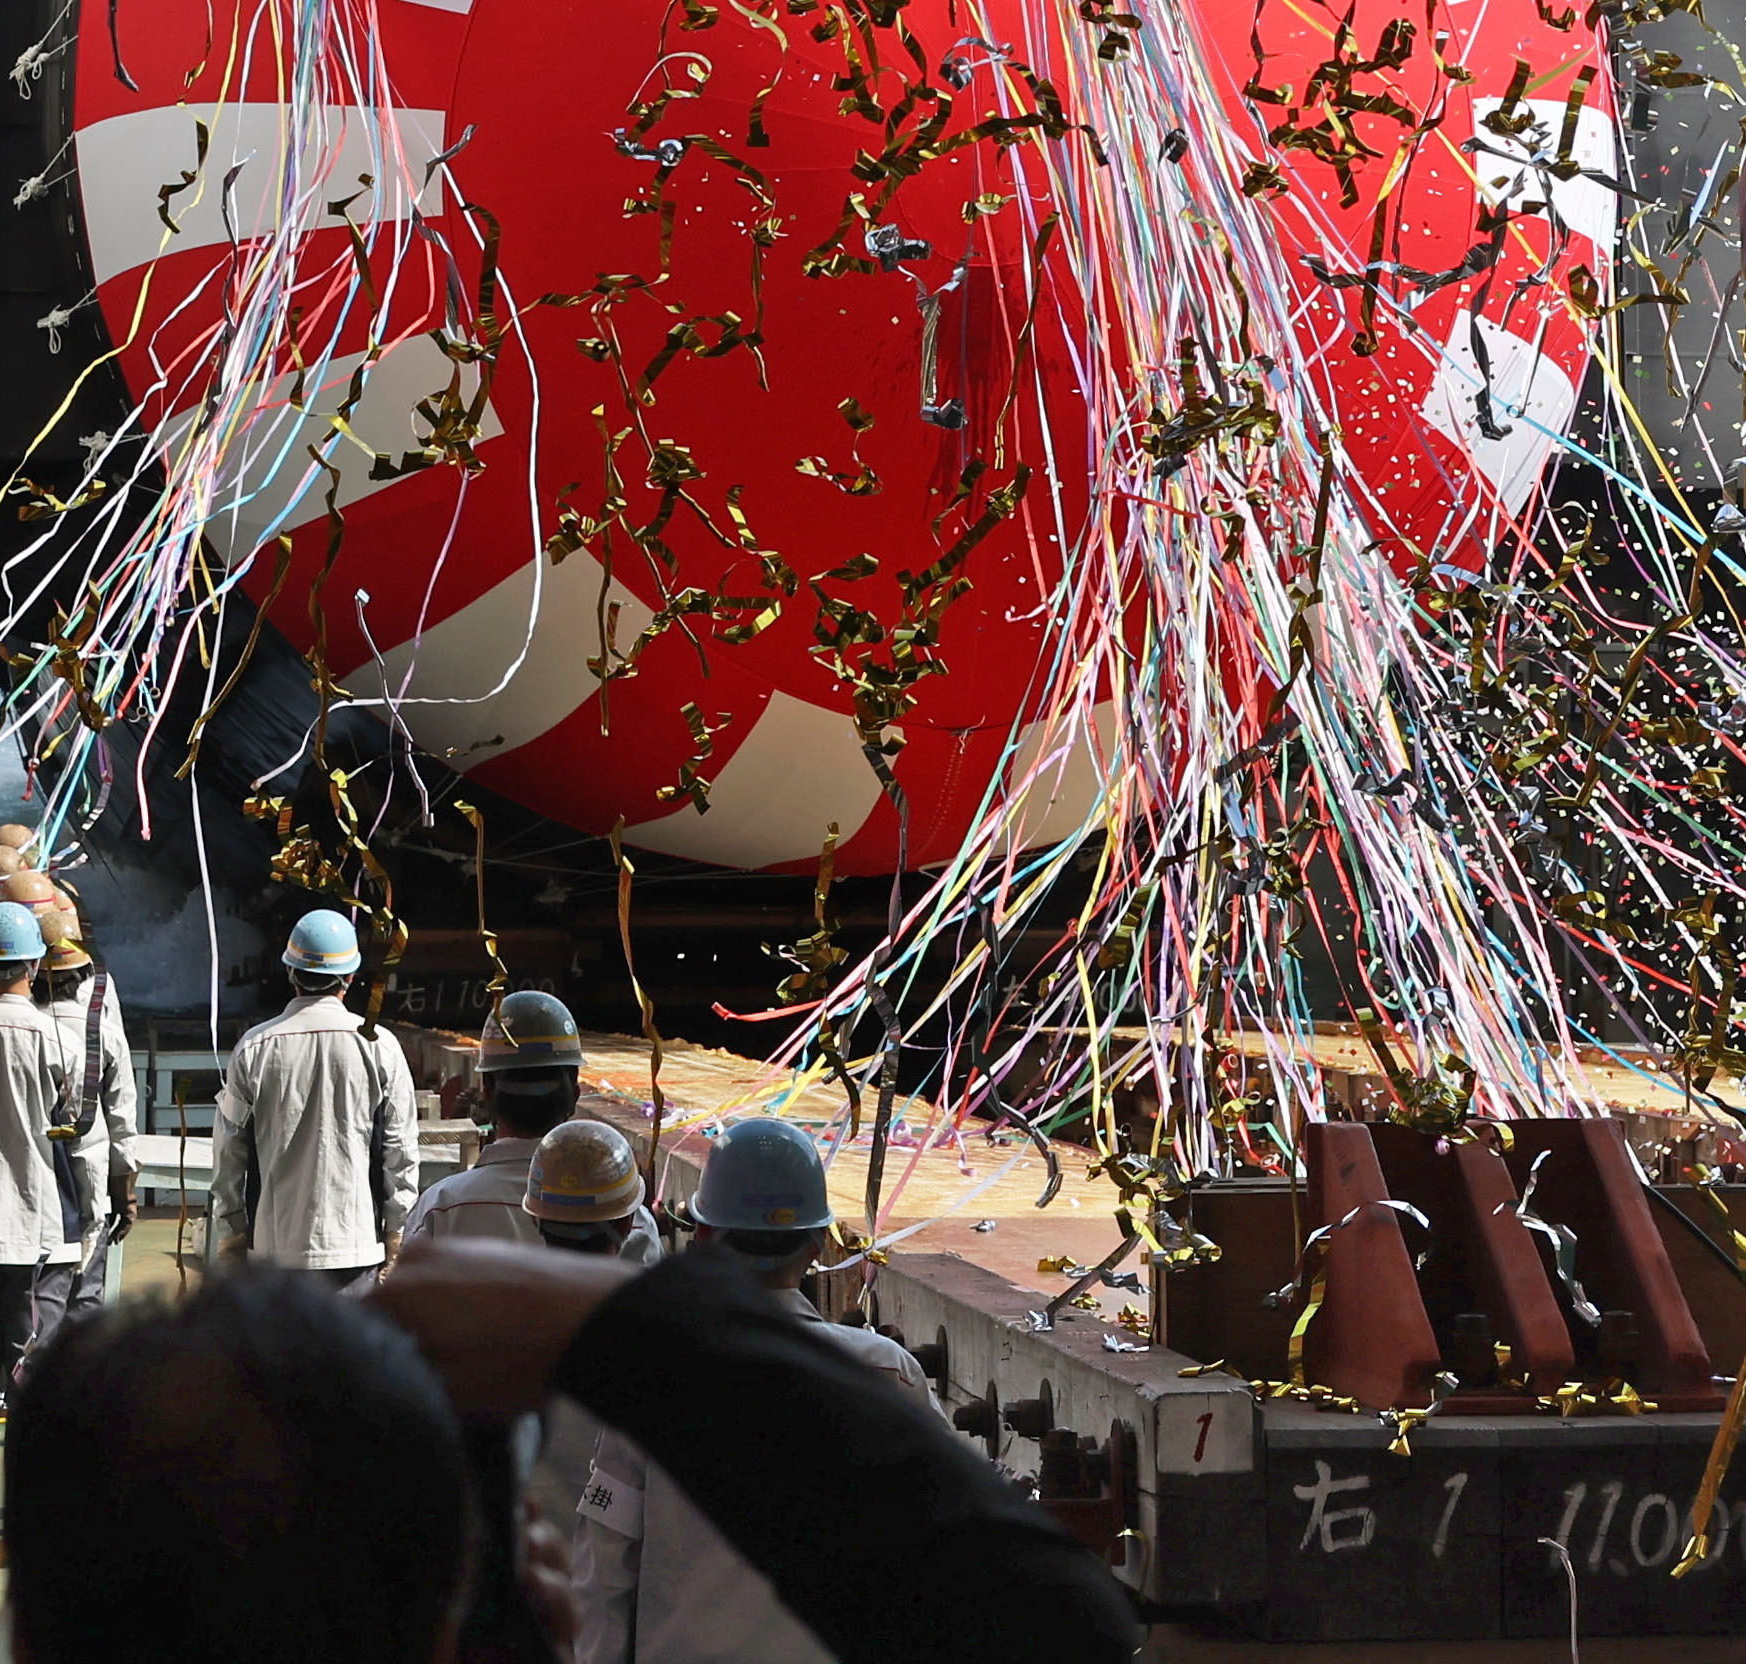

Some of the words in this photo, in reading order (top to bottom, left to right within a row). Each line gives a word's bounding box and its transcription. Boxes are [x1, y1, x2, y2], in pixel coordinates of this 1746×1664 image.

[397, 984, 426, 1013] 右
[1196, 1412, 1214, 1463] 1
[584, 1484, 613, 1511] 掛
[1293, 1459, 1376, 1553] 右
[1432, 1472, 1469, 1557] 1
